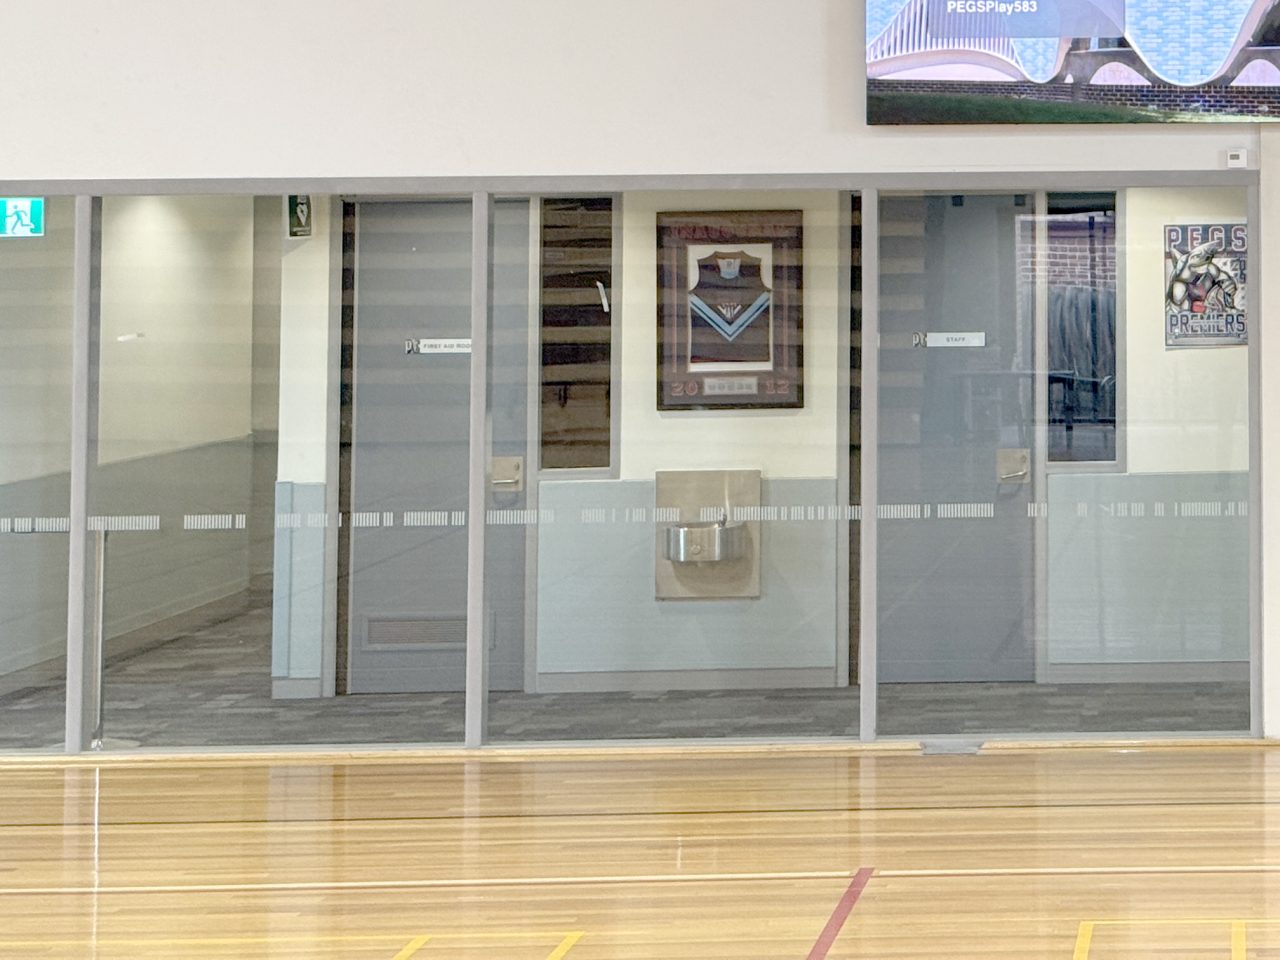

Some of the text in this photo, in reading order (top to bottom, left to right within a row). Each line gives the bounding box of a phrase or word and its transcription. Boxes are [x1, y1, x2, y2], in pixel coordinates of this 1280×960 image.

[947, 0, 1038, 15] PEGSPlay583
[1166, 226, 1247, 251] PEGS
[1169, 313, 1245, 333] PREMIERS
[671, 381, 698, 396] 20
